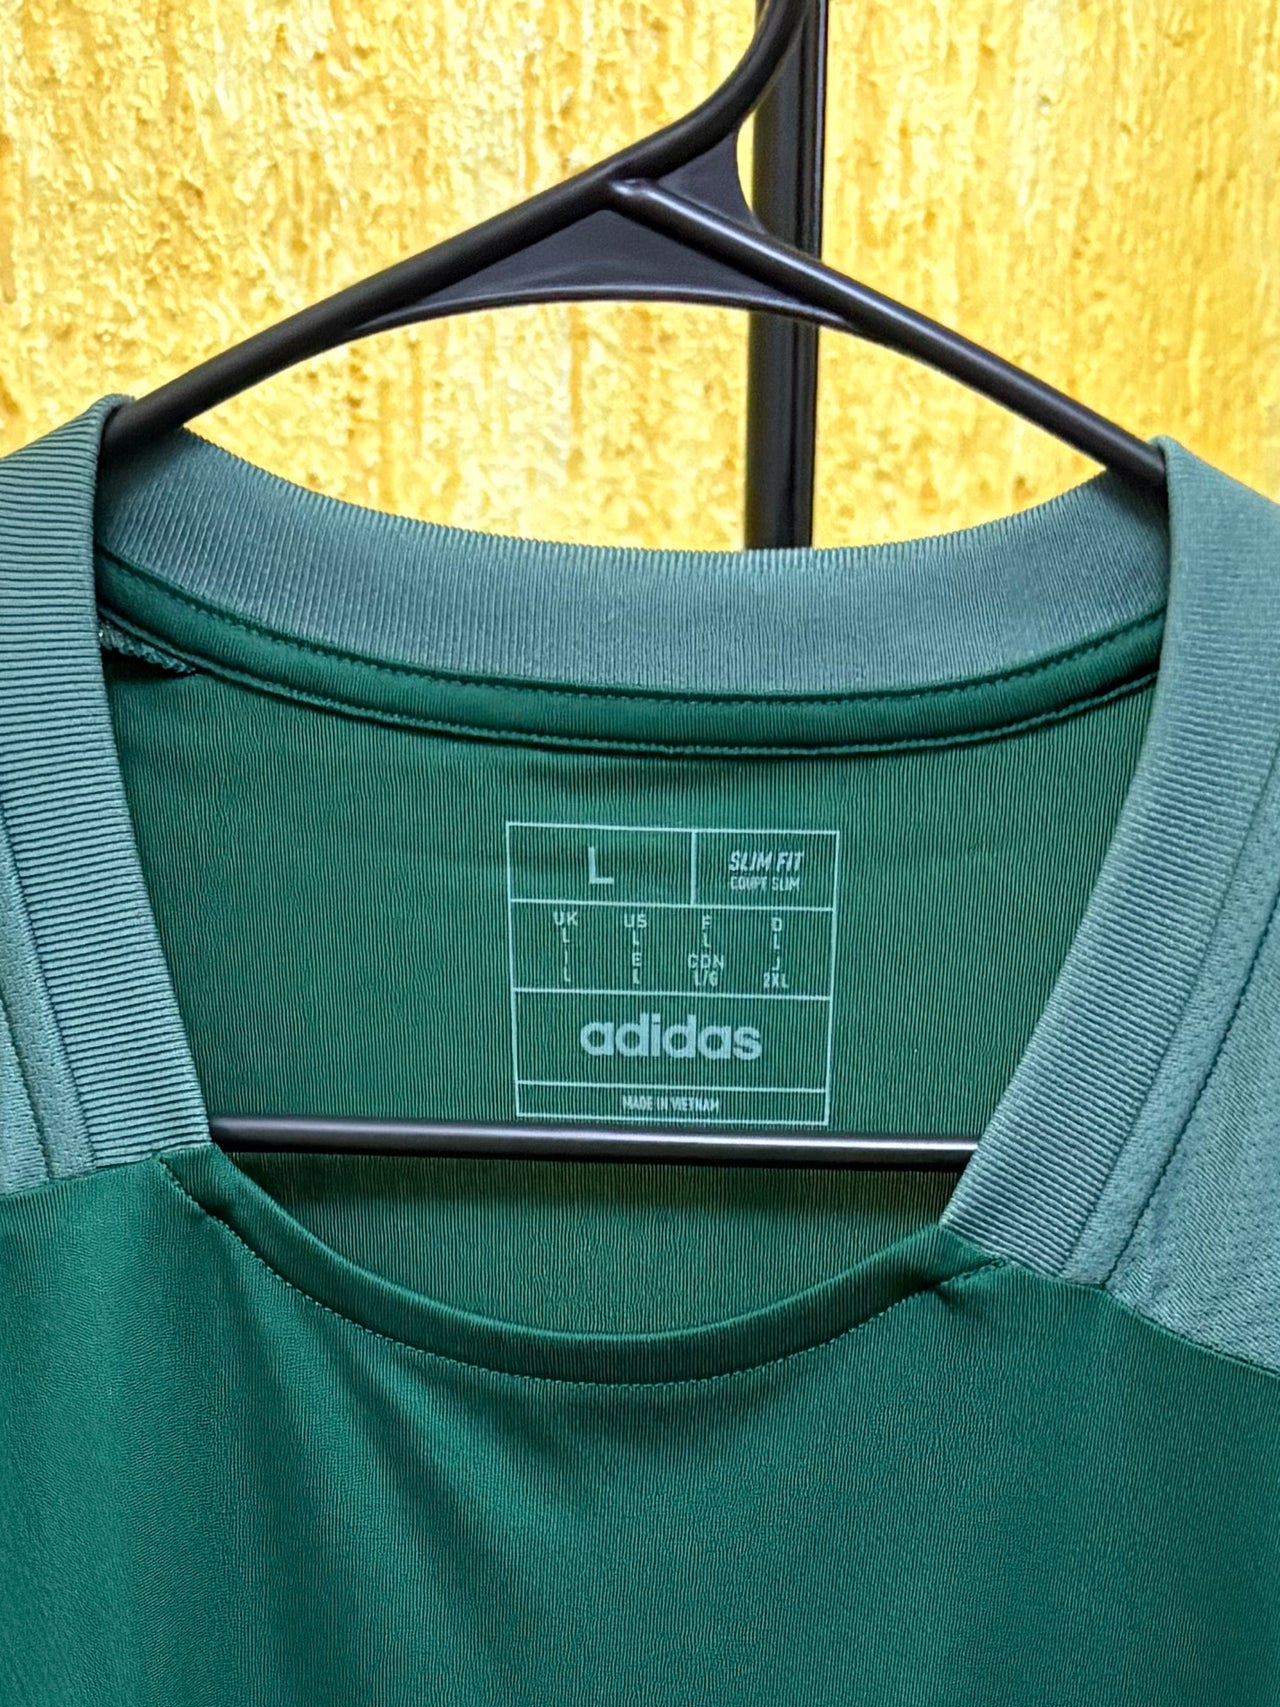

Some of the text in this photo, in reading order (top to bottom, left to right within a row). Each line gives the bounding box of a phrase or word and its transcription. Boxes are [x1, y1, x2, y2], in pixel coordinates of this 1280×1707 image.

[588, 846, 615, 885] L
[728, 850, 805, 872] SLIM FIT
[771, 876, 800, 892] SLIM
[553, 911, 783, 932] UK US F D
[562, 927, 780, 949] L L L L
[631, 952, 642, 967] E
[687, 953, 725, 969] CDN
[772, 956, 780, 971] J
[693, 970, 719, 987] L/G
[763, 971, 790, 989] 2XL
[580, 1012, 763, 1060] adidas
[622, 1095, 719, 1113] MADE IN VIETNAM
